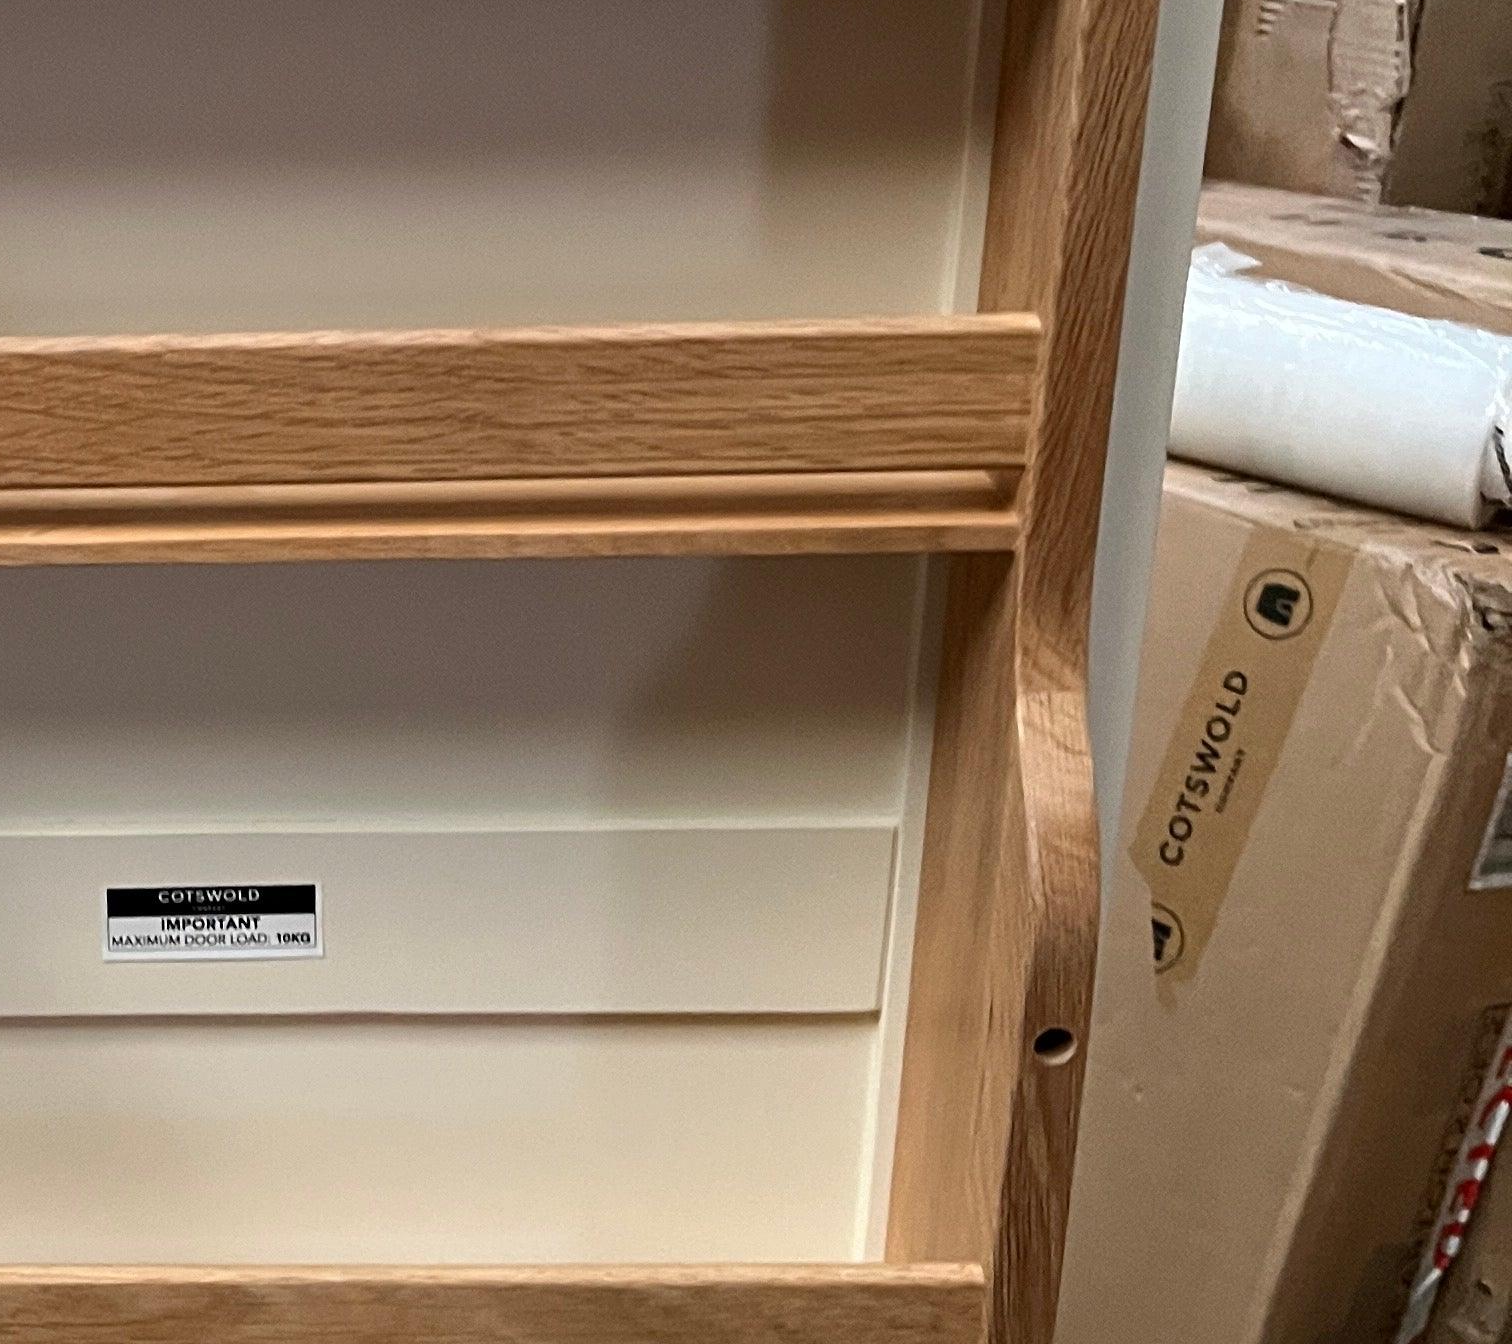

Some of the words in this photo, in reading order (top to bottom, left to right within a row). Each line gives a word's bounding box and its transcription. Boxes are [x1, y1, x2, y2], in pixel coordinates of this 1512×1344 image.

[1160, 669, 1249, 867] COTSWOLD
[157, 888, 261, 905] COTSWOLD
[161, 916, 262, 932] IMPORTANT
[111, 934, 181, 947] MAXIMUM
[184, 933, 226, 946] DOOR
[276, 932, 311, 944] 10KG
